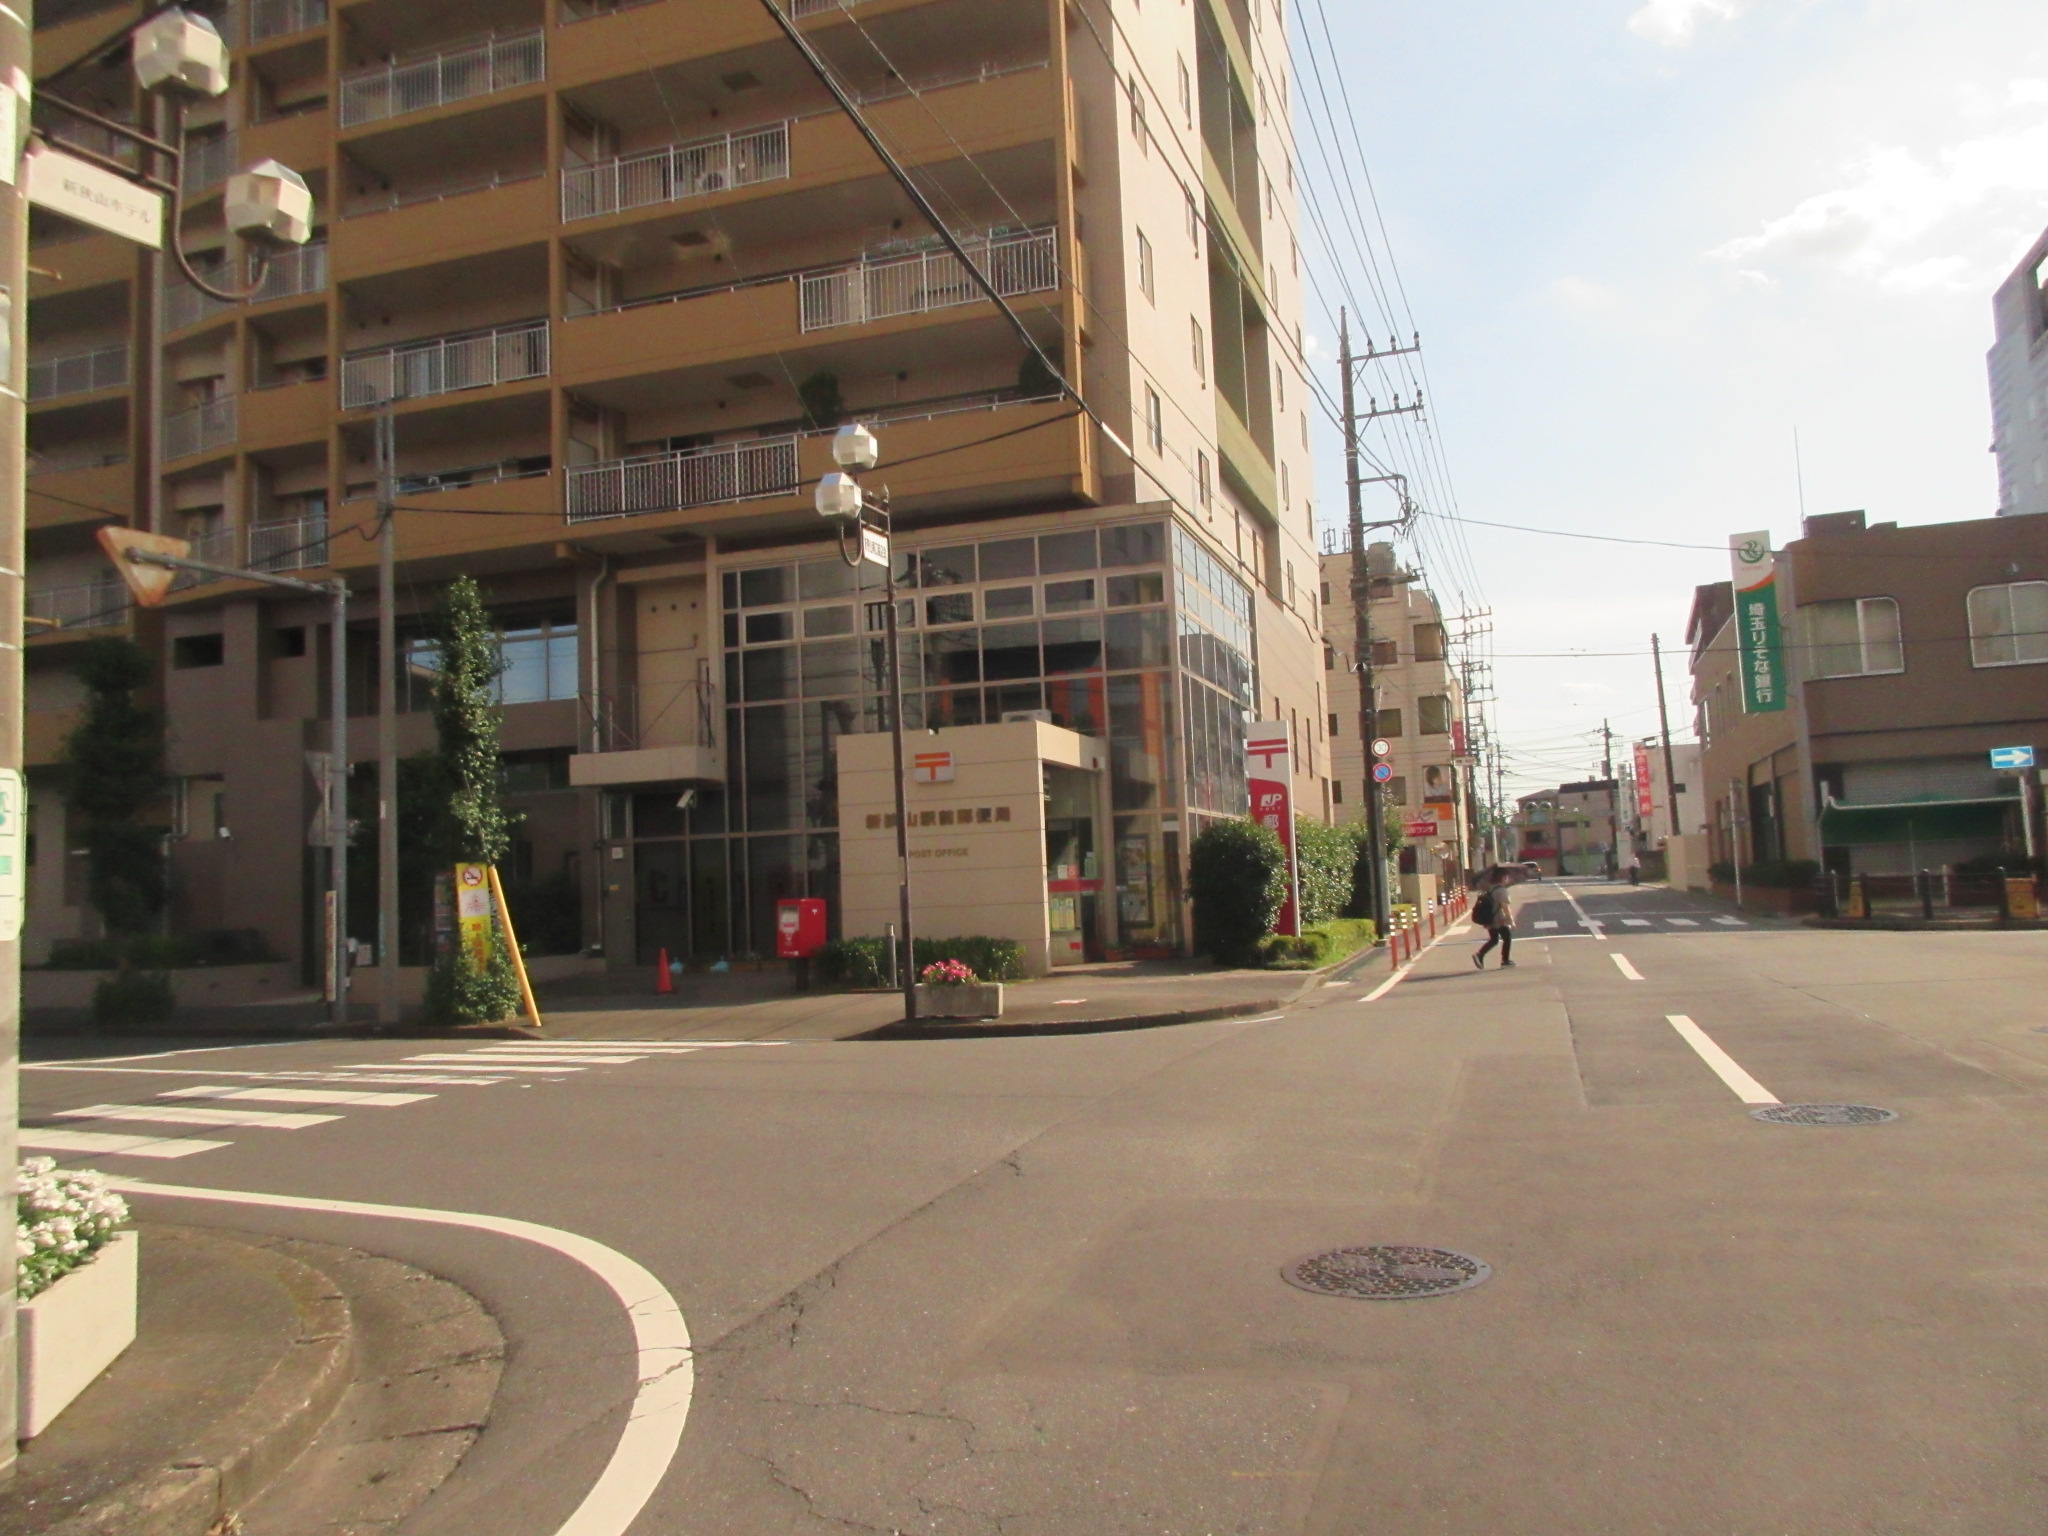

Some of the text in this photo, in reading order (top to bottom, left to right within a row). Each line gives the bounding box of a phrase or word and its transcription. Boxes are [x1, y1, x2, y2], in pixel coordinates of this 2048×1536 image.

[1748, 602, 1773, 703] 埼玉りそな銀行
[908, 847, 969, 859] POST OFFICE
